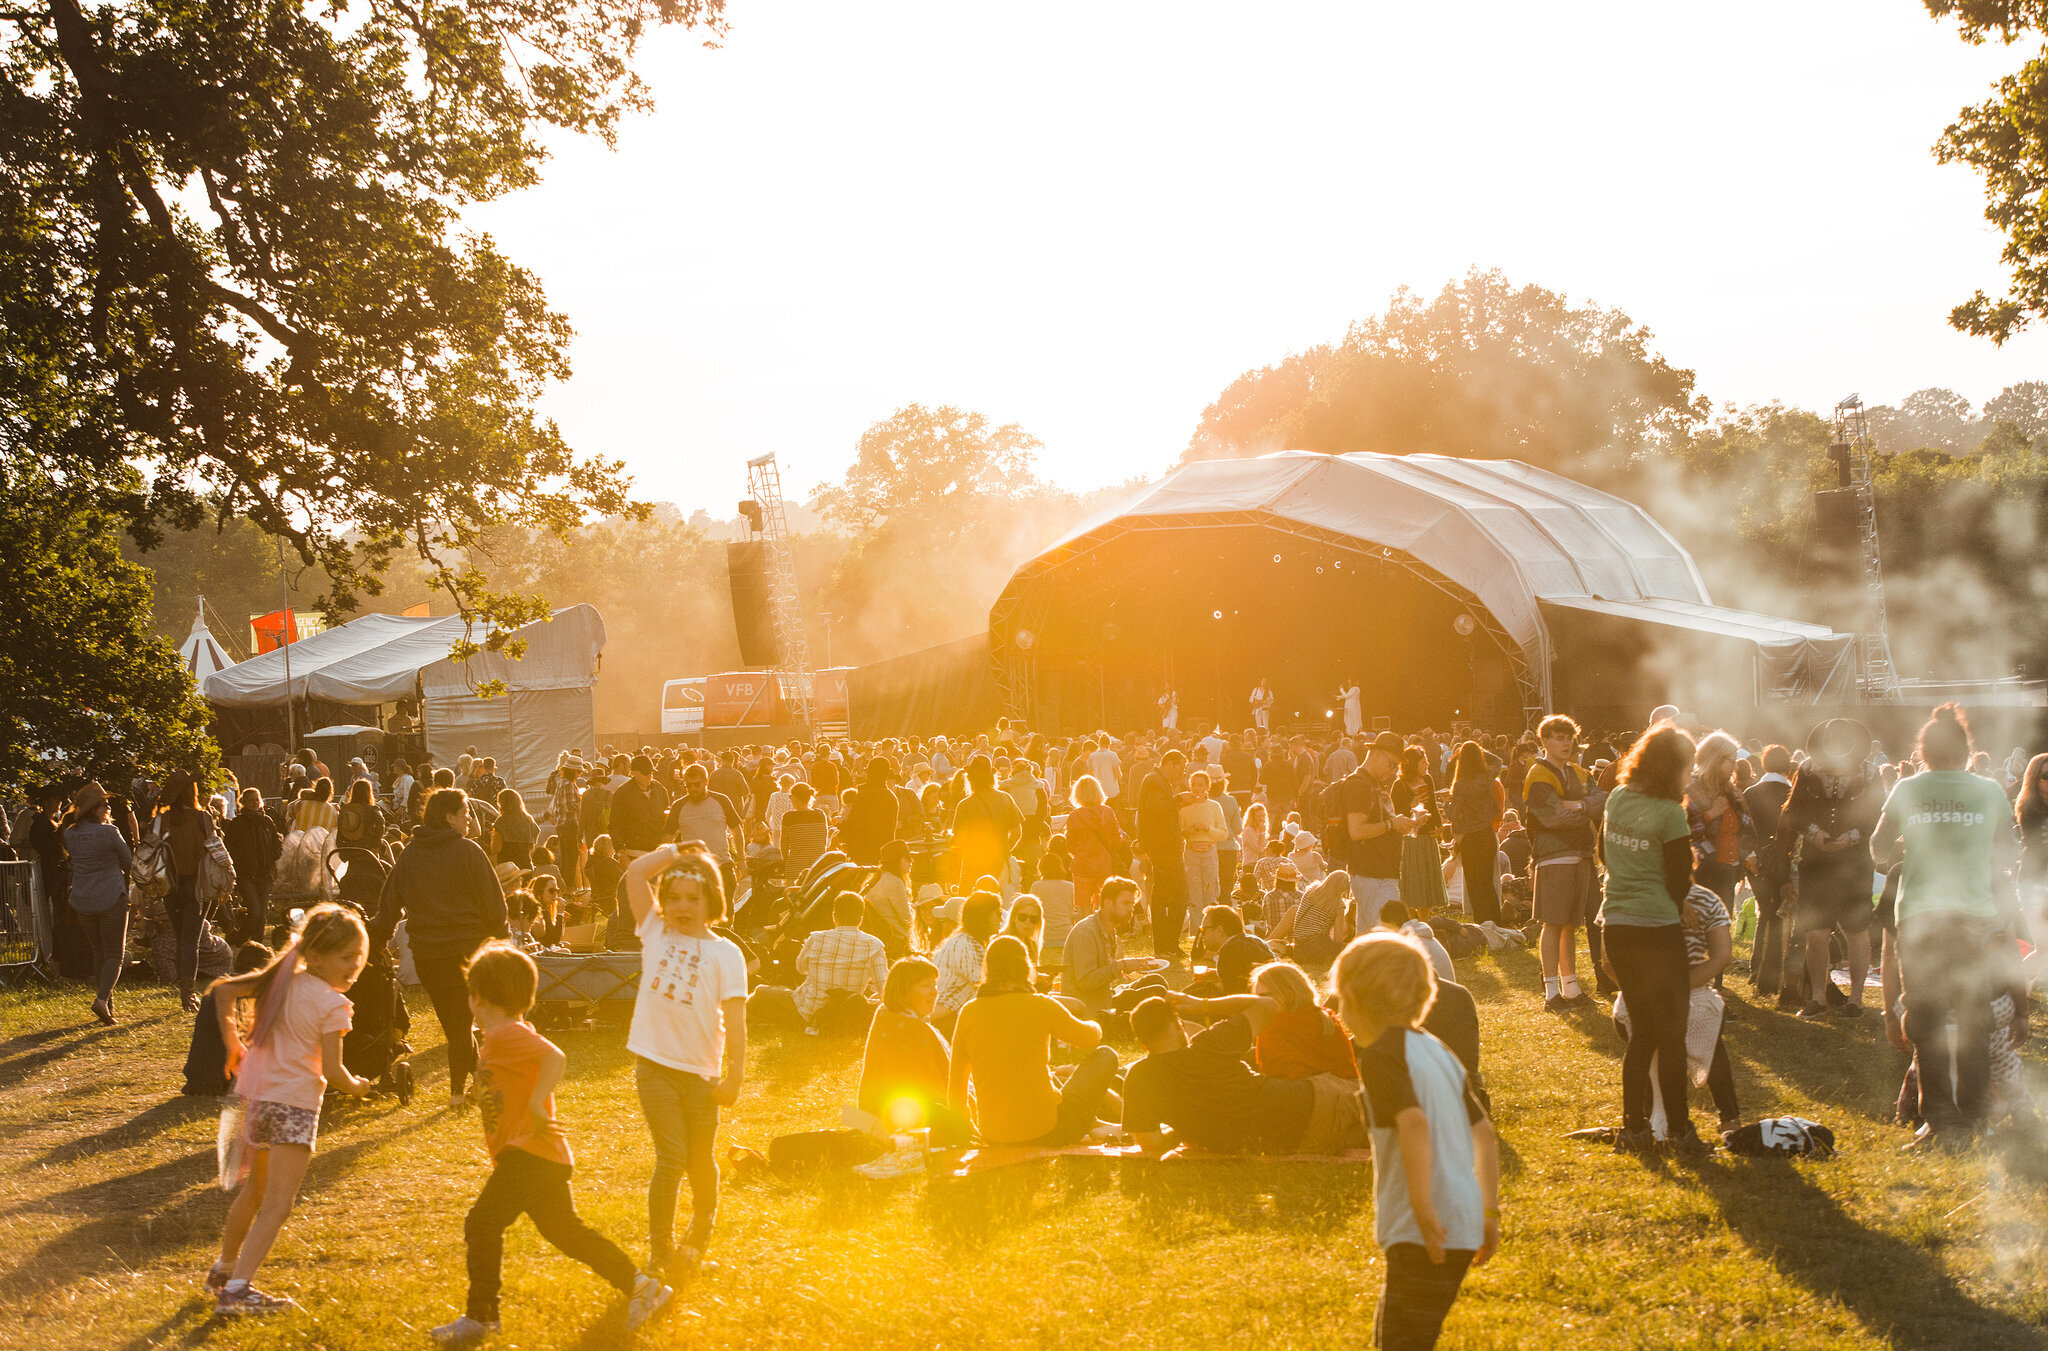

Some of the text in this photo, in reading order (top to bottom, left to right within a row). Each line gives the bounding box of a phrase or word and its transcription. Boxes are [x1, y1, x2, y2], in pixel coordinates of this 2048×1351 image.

[296, 616, 320, 627] GENCY
[725, 683, 754, 697] VFB
[1907, 811, 1985, 827] massage
